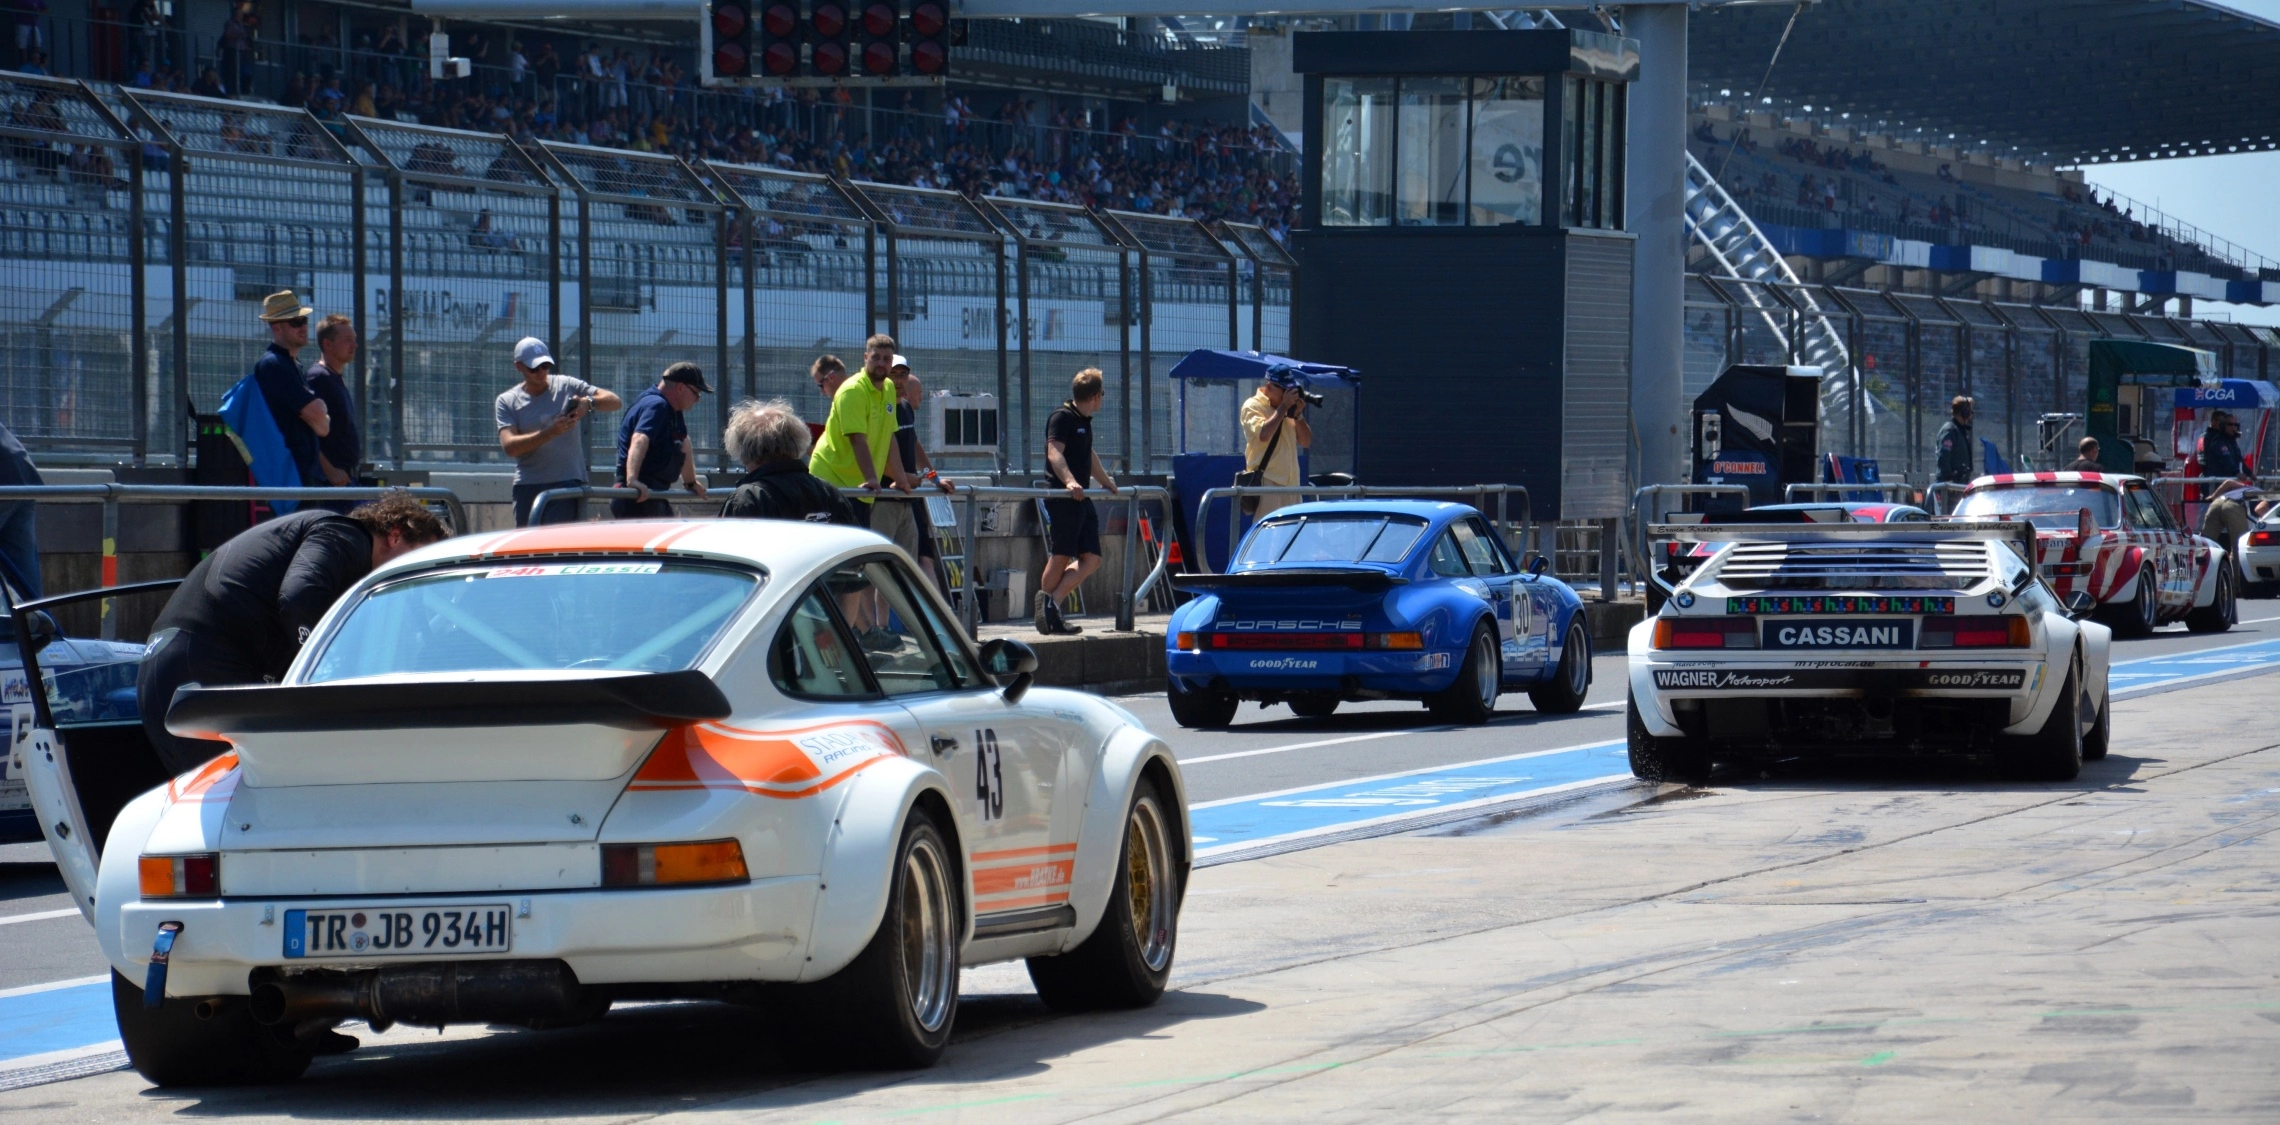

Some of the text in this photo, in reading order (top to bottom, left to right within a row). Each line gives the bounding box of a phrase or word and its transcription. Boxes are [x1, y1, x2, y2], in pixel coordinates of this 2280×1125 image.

[375, 288, 420, 327] BW
[1005, 309, 1037, 340] Poer
[2204, 388, 2236, 401] CGA
[1713, 461, 1767, 474] O'CONNELL
[1657, 525, 1685, 534] Erwin
[1929, 522, 2019, 532] Rainer Dippelhofer
[494, 564, 658, 577] 24h Classic
[1514, 593, 1530, 636] 30
[1215, 620, 1363, 630] PORSCHE
[1778, 627, 1899, 646] CASSANI
[1250, 657, 1318, 669] GOODYEAR
[1657, 671, 1795, 688] WAGNER Motorsport
[1929, 671, 2021, 687] GOODYEAR
[823, 745, 872, 764] RACING
[975, 728, 1004, 821] 43
[306, 910, 507, 951] TR JB 934H
[291, 939, 299, 949] D
